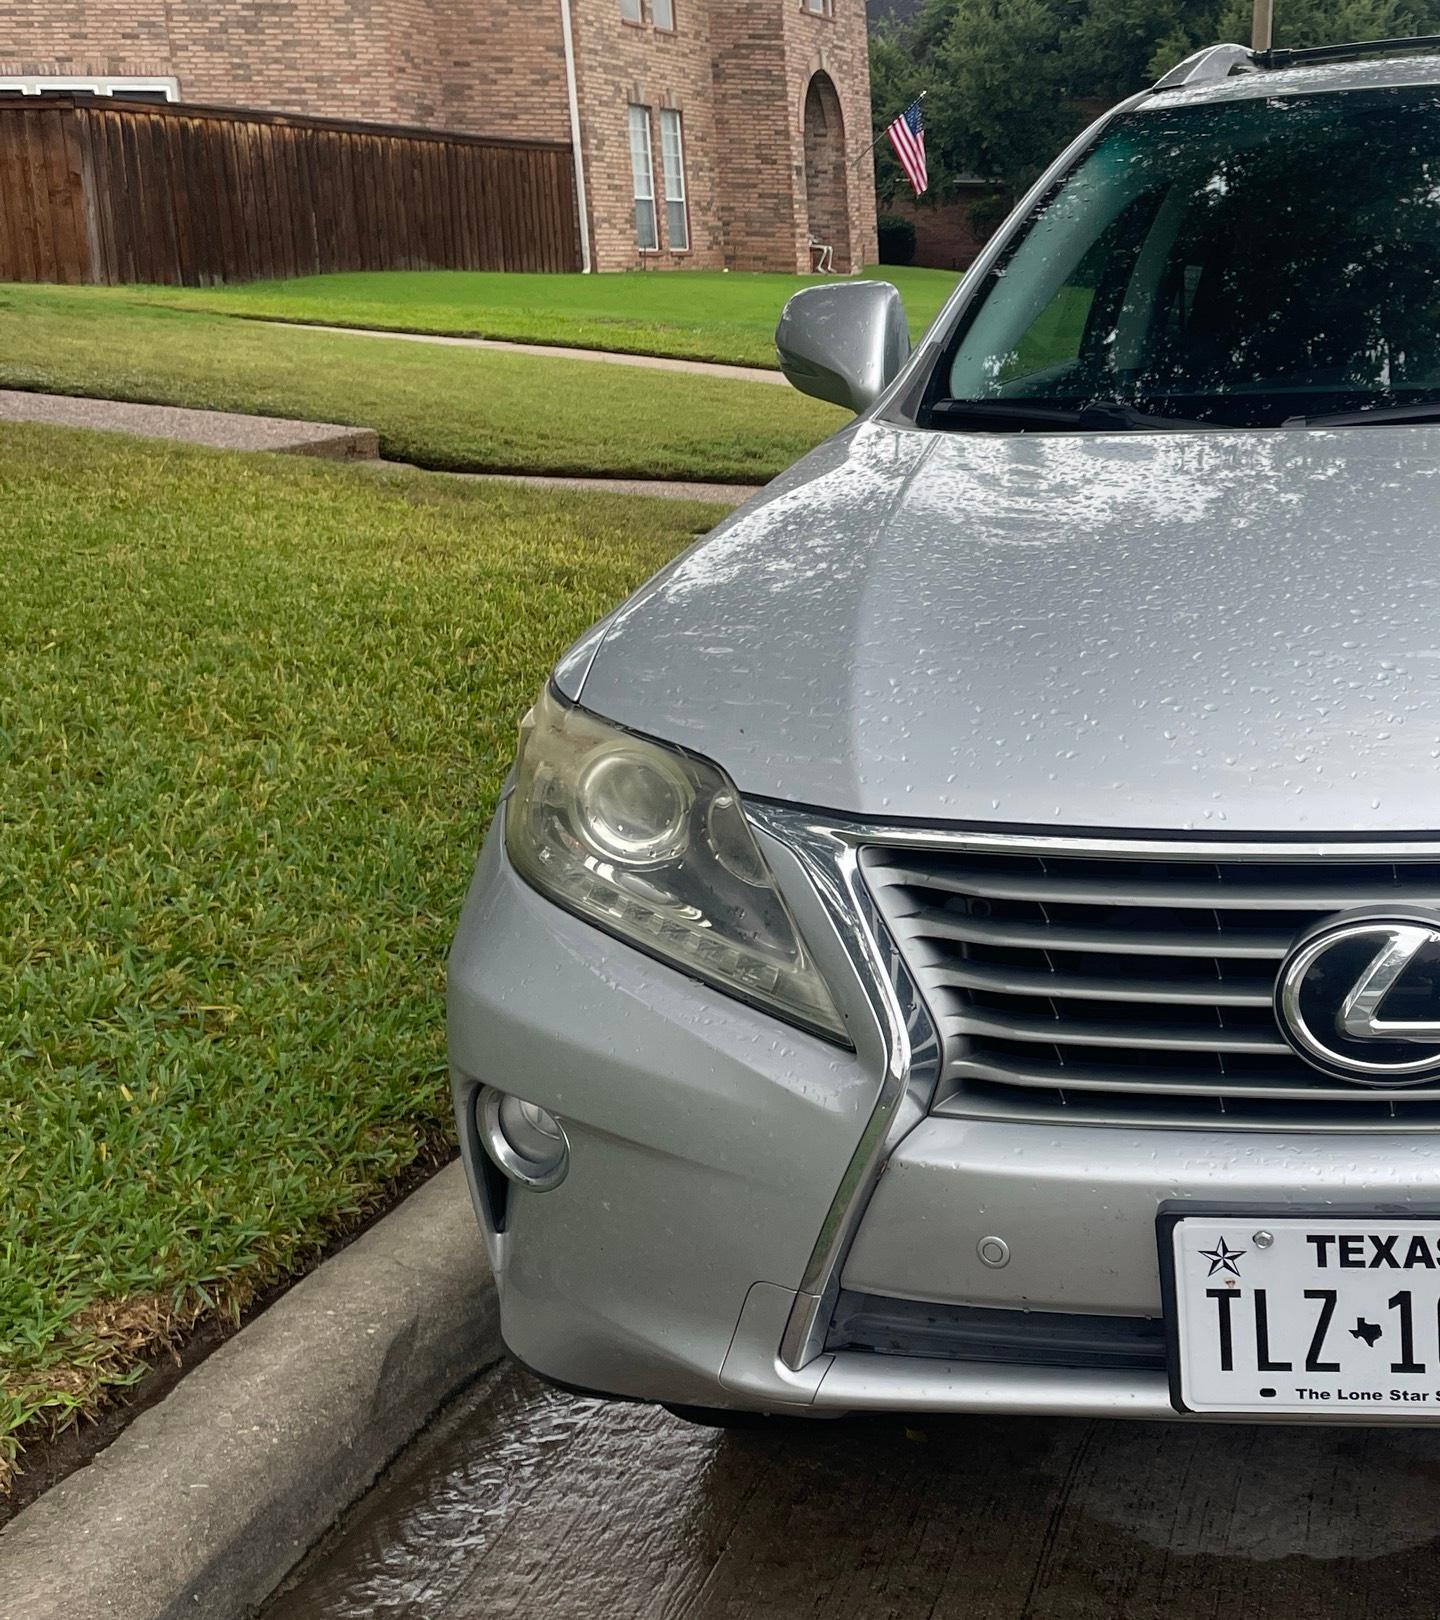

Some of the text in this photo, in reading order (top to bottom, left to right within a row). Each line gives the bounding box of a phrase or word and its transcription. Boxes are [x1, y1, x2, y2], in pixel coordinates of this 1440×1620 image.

[1206, 1288, 1341, 1373] TLZ
[1295, 1388, 1331, 1400] The
[1337, 1389, 1383, 1401] Lone
[1389, 1389, 1429, 1402] Star
